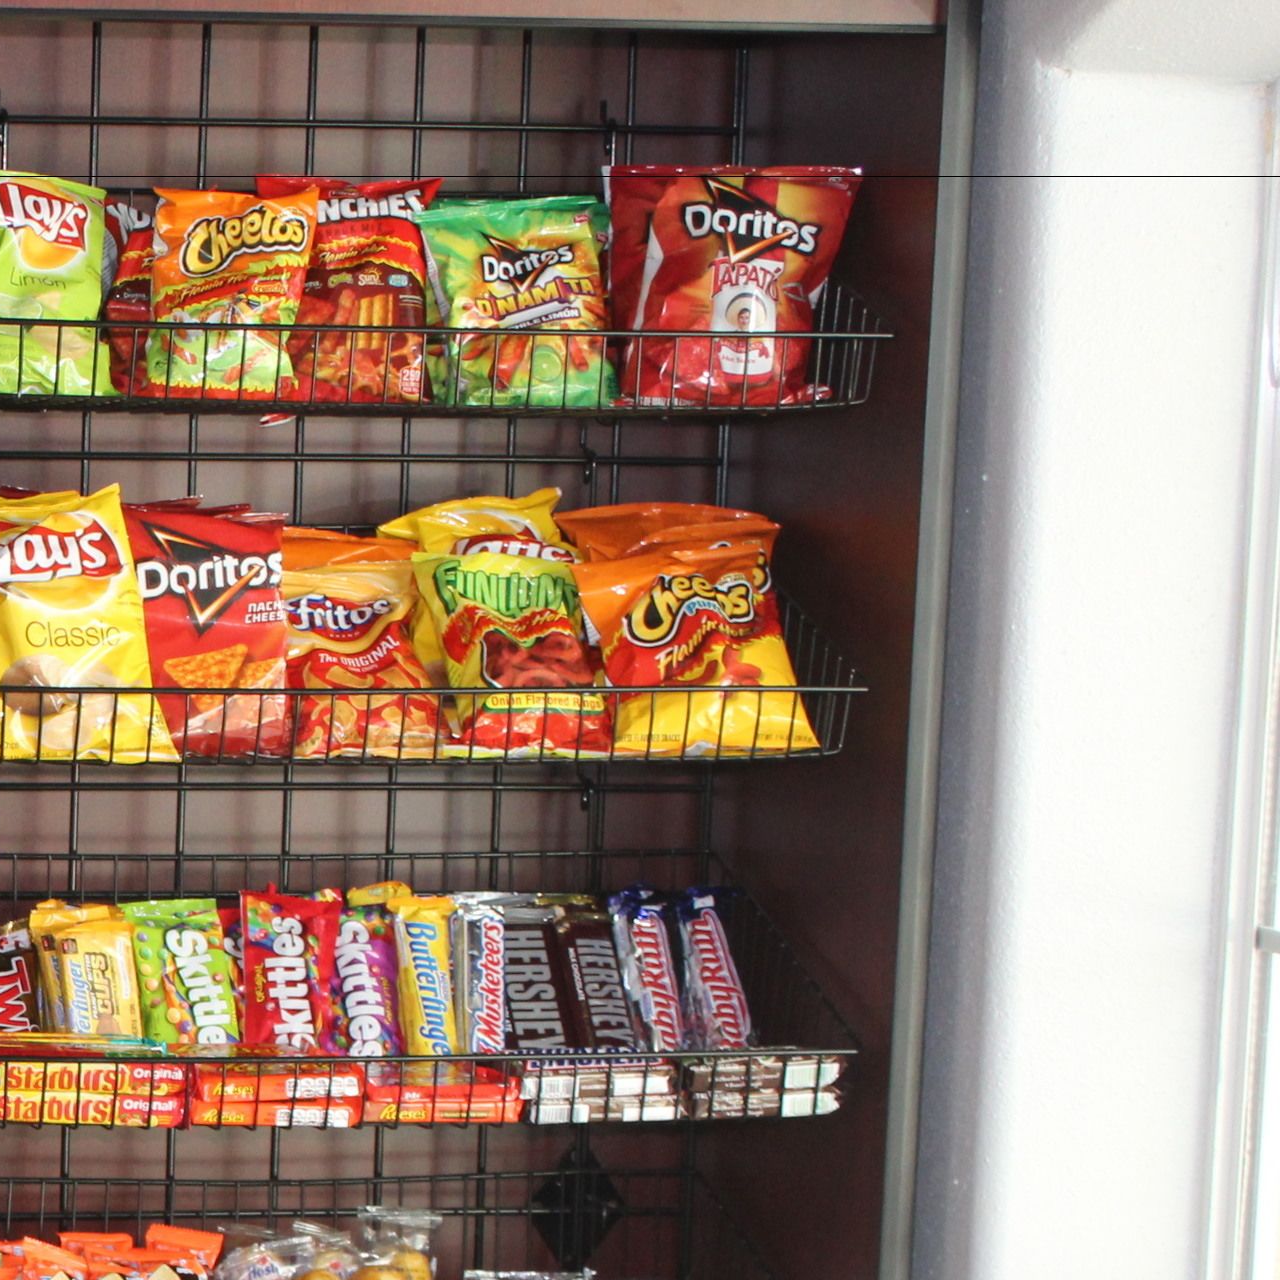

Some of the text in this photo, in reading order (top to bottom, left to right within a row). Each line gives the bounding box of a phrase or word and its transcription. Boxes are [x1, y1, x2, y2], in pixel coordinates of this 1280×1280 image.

[6, 182, 88, 243] Lay's
[684, 204, 818, 253] Doritos
[182, 206, 308, 276] Cheetos
[482, 246, 573, 282] Doritos
[137, 551, 283, 598] Doritos
[245, 611, 284, 624] CHEES
[248, 601, 284, 613] NACH
[288, 594, 392, 632] Fritos
[24, 620, 122, 649] Classic
[340, 634, 401, 668] ORIGINAL
[491, 695, 522, 707] Onion
[525, 694, 571, 707] Flavored
[95, 951, 110, 1017] CUPS
[164, 928, 227, 1044] Skittle
[263, 917, 316, 1049] Skittles
[335, 920, 384, 1057] Skittles
[405, 921, 452, 1056] Butterfinge
[473, 920, 504, 1048] Musketeers
[6, 1065, 185, 1092] Starburst Original
[122, 1098, 178, 1112] Original
